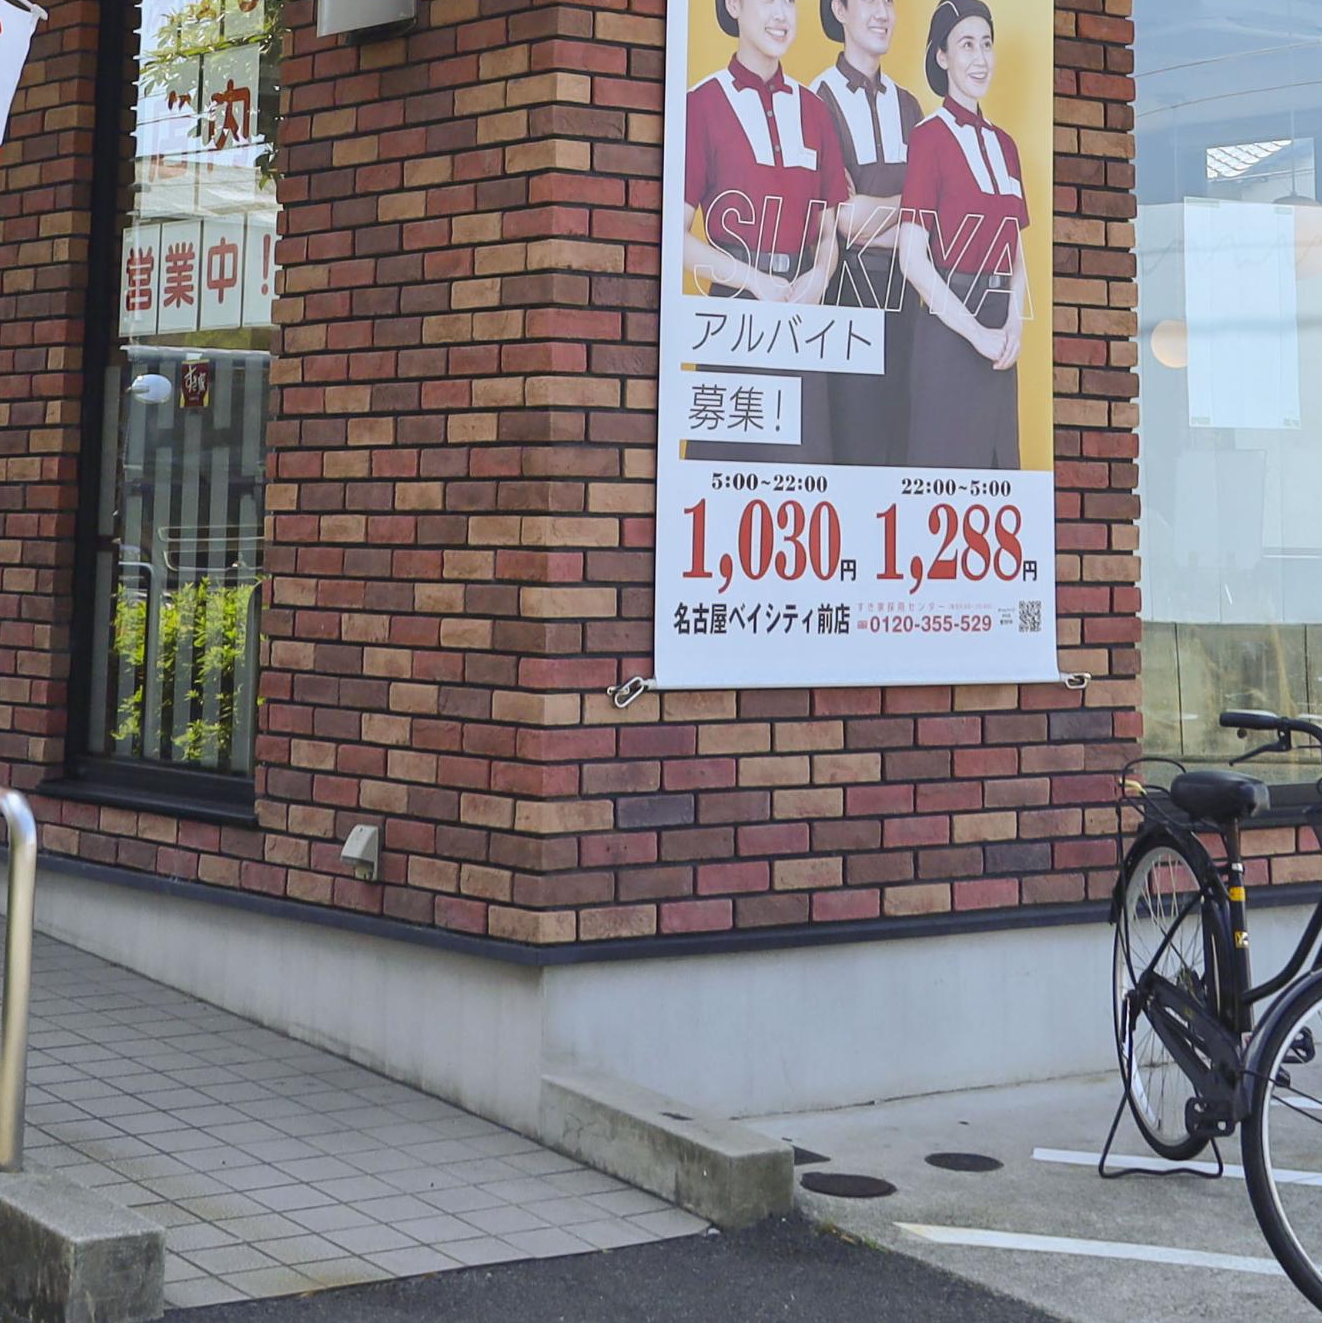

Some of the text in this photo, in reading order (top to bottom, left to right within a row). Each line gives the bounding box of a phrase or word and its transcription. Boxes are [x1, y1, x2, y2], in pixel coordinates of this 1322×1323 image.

[694, 189, 1035, 321] SUKIYA
[692, 311, 872, 360] アルバイト
[682, 497, 857, 594] 1,030円
[876, 502, 1038, 595] 1,288円
[673, 601, 850, 636] 名古屋ベイシティ前店
[870, 615, 992, 633] 0120-355-529
